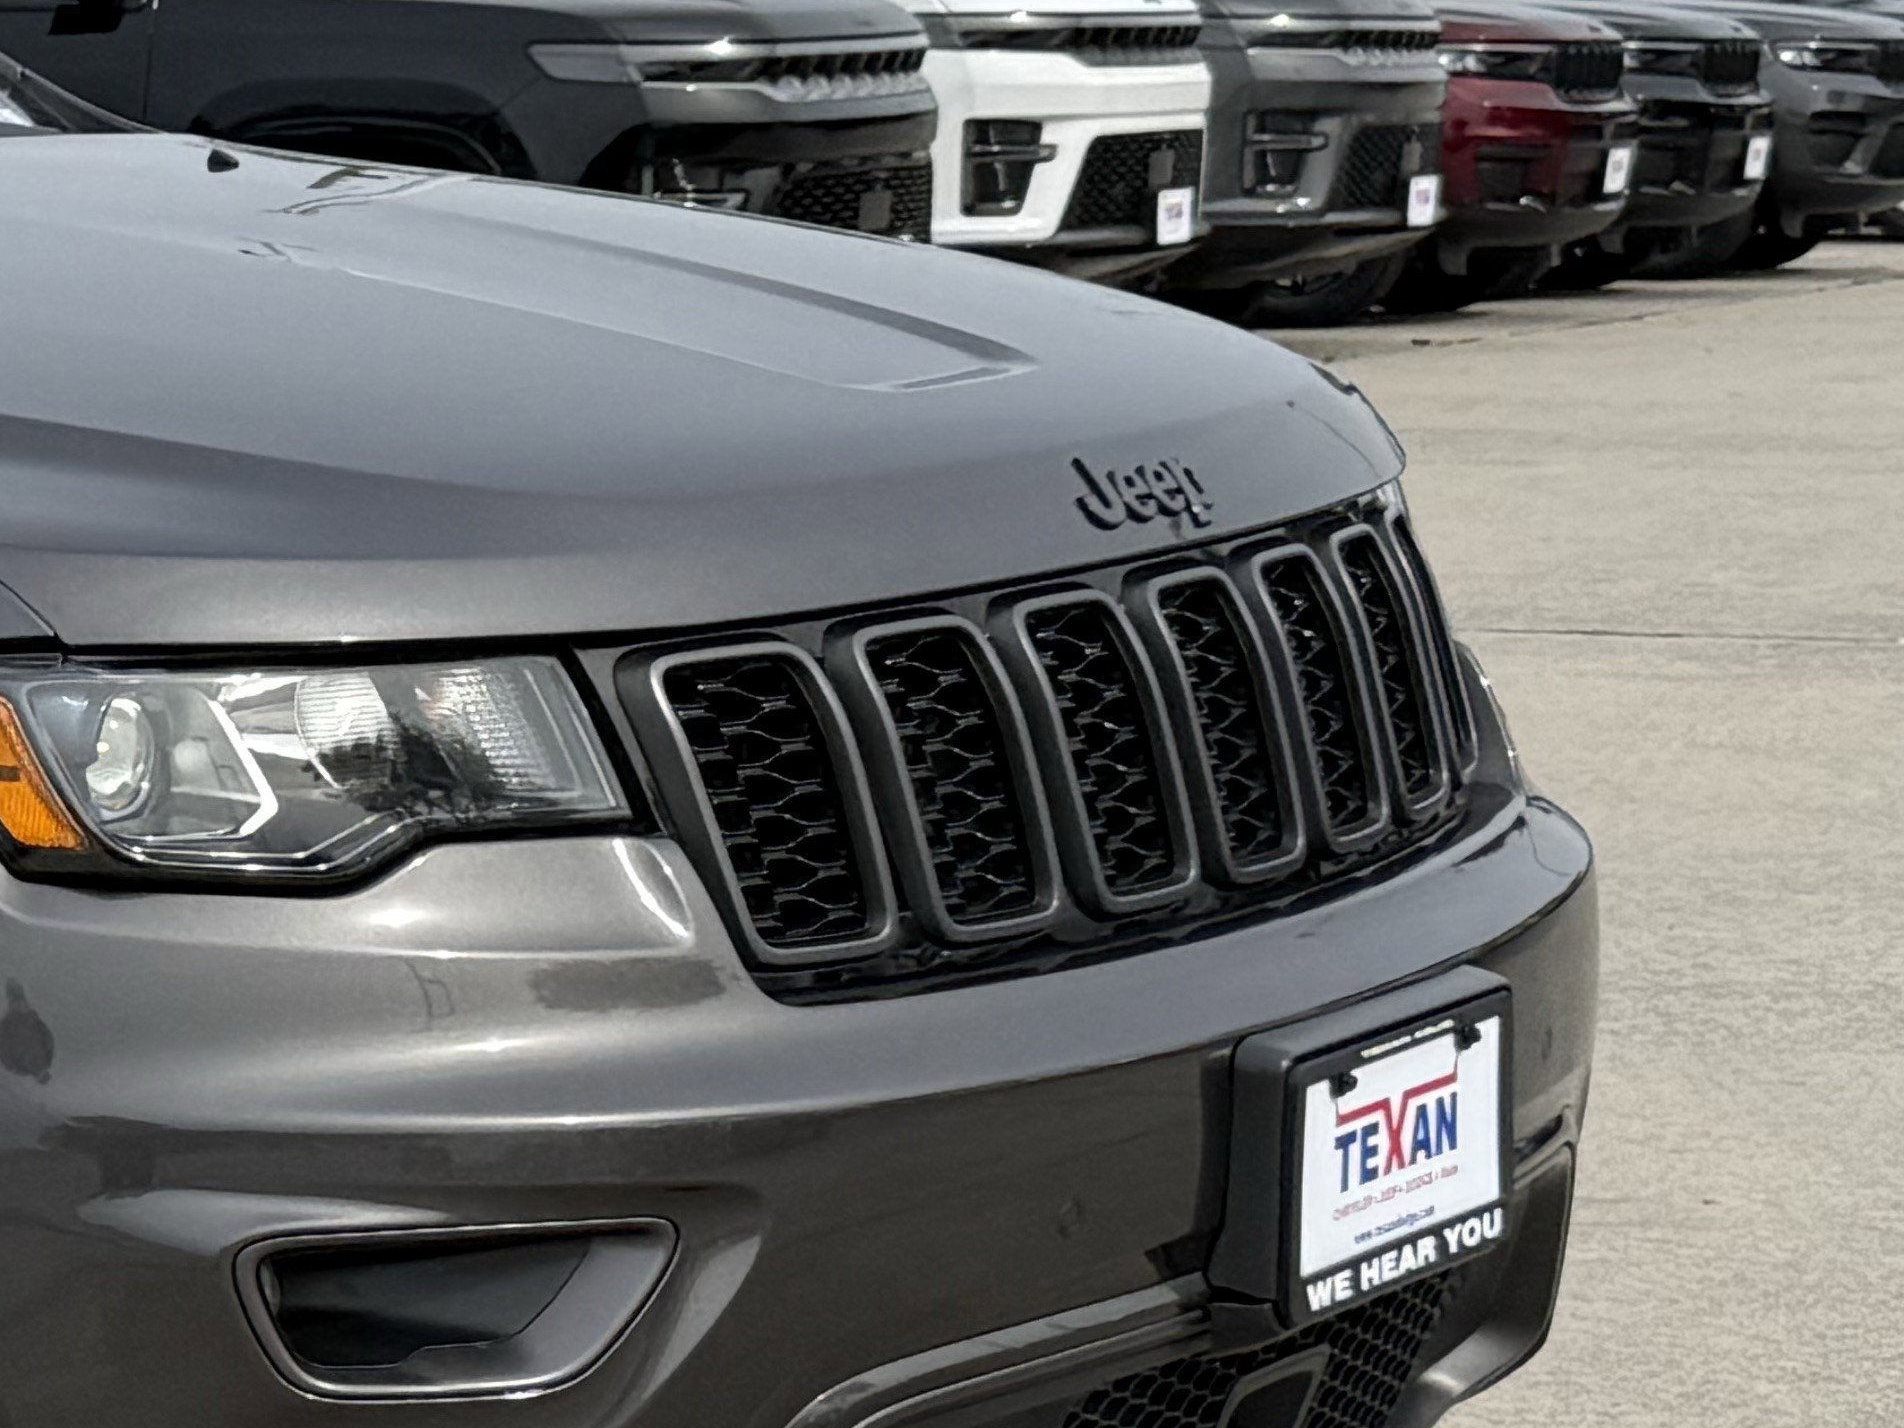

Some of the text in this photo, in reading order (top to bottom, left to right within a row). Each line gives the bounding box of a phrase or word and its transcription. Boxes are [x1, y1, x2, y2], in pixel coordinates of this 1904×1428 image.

[1070, 457, 1213, 531] Jeep
[1334, 1082, 1459, 1194] TEXAN
[1306, 1268, 1354, 1312] WE
[1360, 1235, 1437, 1293] HEAR
[1443, 1207, 1504, 1255] YOU
